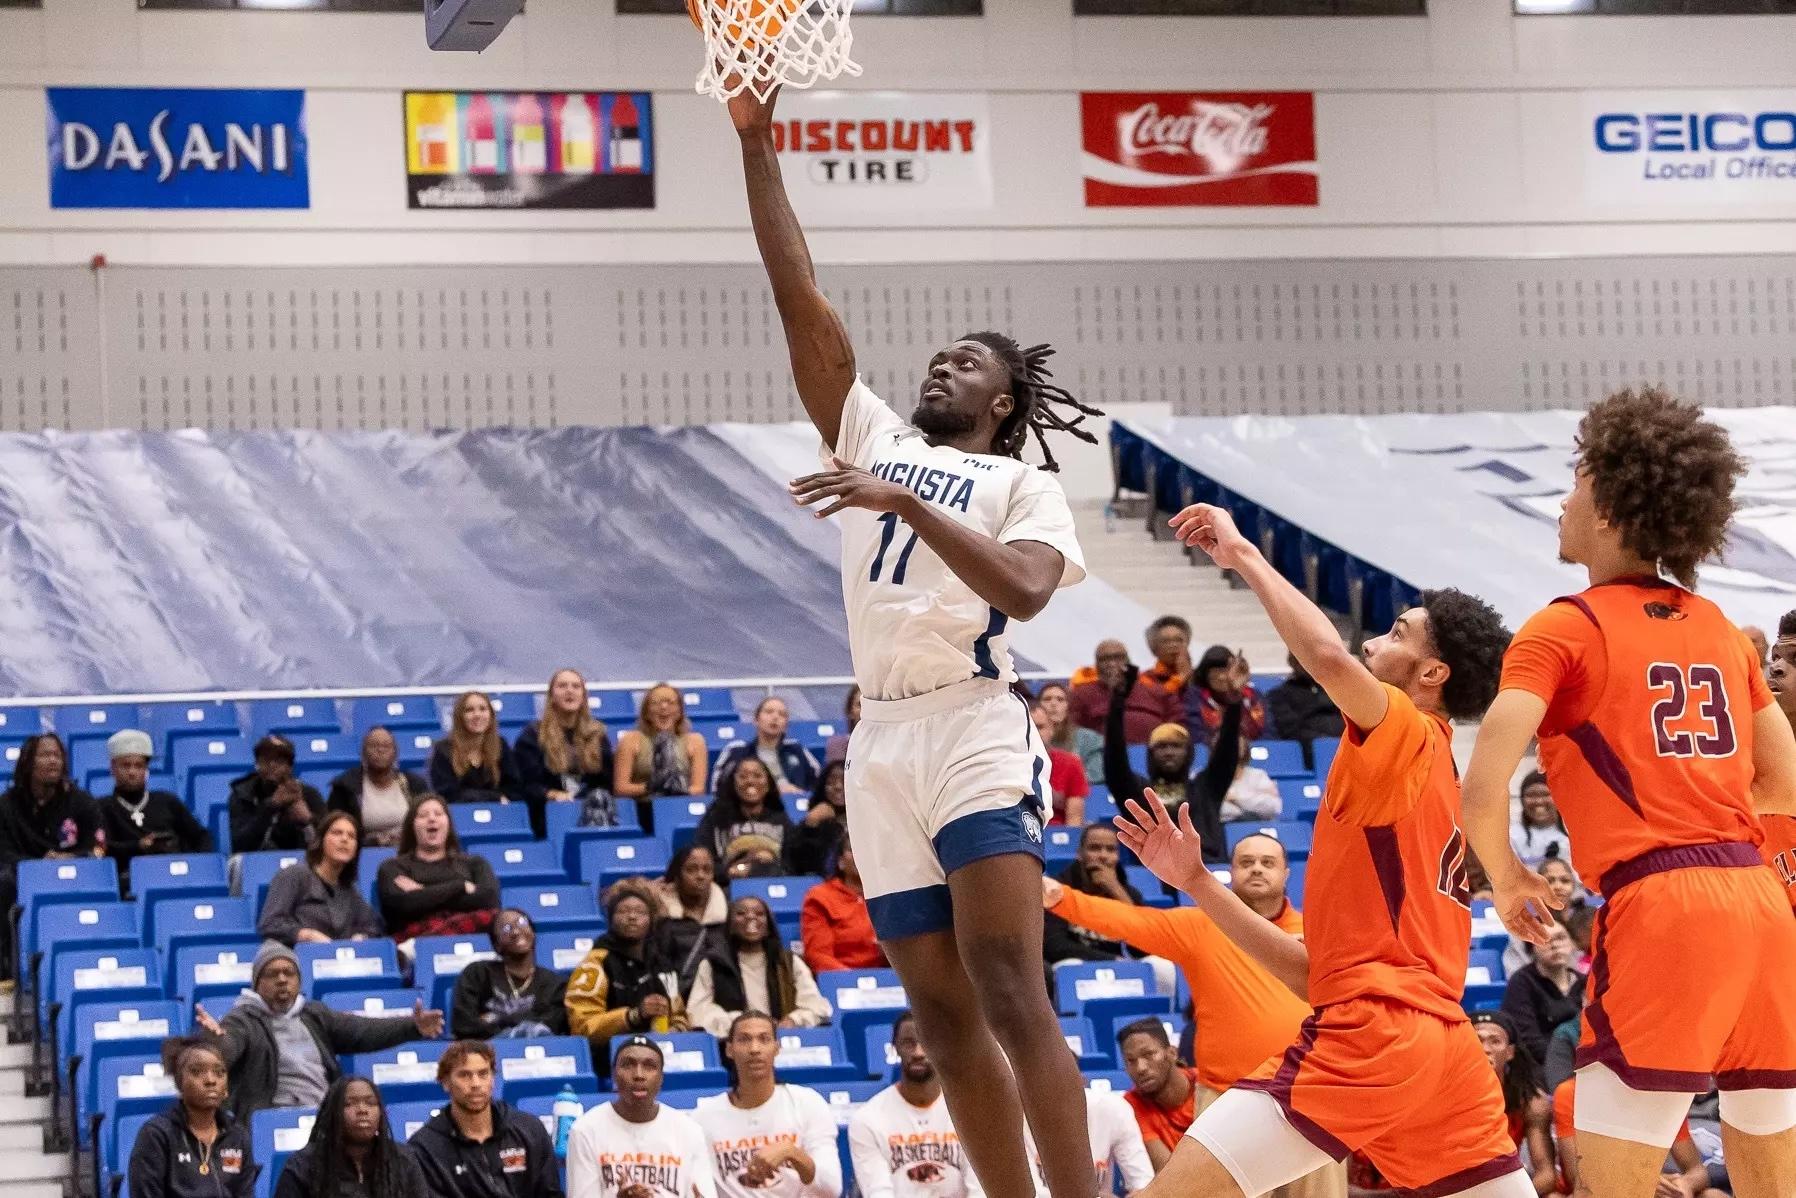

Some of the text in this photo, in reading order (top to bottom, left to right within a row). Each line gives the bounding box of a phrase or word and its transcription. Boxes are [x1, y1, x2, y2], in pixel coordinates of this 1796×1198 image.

[62, 108, 288, 184] DASANI
[1594, 112, 1796, 152] GEICO
[820, 160, 915, 182] TIRE
[1643, 158, 1715, 180] Local
[869, 511, 920, 586] 11
[1646, 661, 1738, 759] 23
